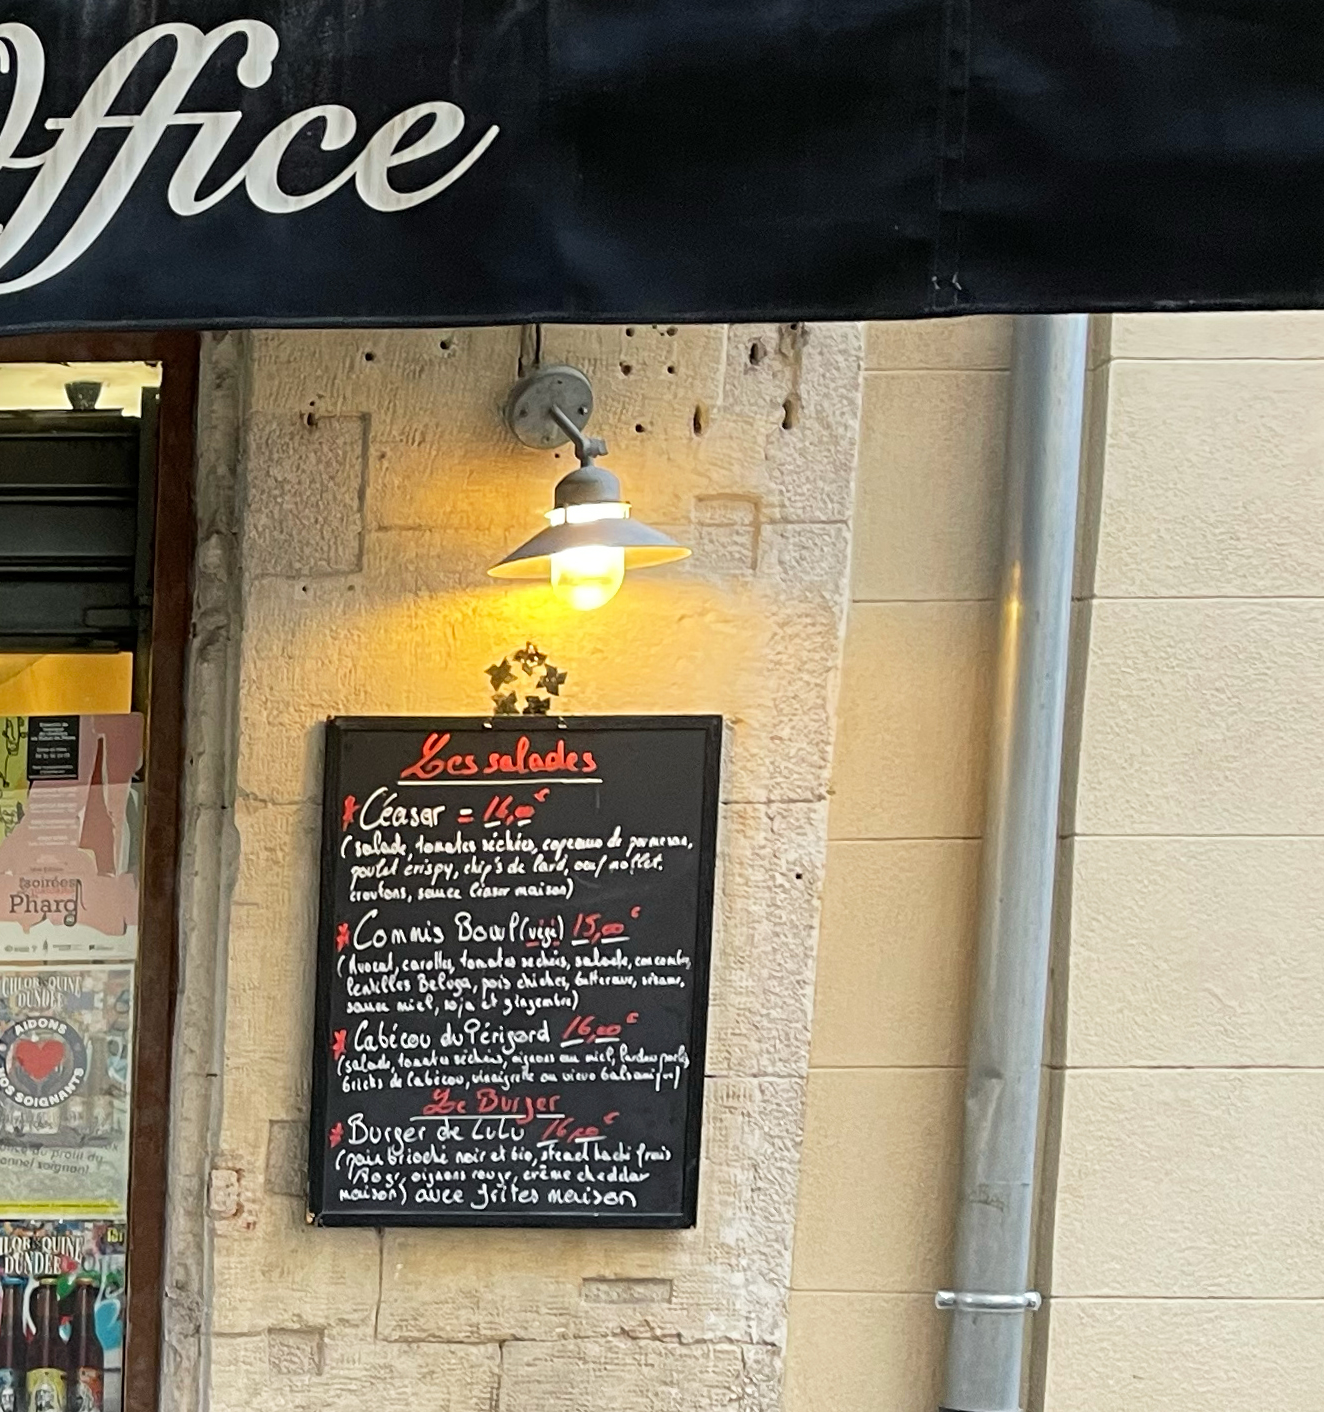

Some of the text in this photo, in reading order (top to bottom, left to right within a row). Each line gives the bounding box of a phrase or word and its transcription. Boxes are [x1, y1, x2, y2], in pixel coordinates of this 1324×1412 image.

[400, 733, 597, 779] Les salades
[360, 786, 445, 828] Céasar
[607, 825, 622, 848] de
[507, 856, 526, 874] de
[353, 908, 445, 950] Commis
[2, 976, 83, 999] CHLORQUINE
[15, 1018, 67, 1036] AIDONS
[354, 1019, 431, 1051] Cabécou
[440, 1022, 463, 1047] du
[14, 1067, 84, 1108] SOIGNANTS
[477, 1090, 560, 1124] Burger
[348, 1113, 426, 1155] Burger
[437, 1118, 464, 1141] de
[415, 1188, 464, 1204] avec
[548, 1187, 637, 1208] maison
[4, 1249, 62, 1275] DUNDEE
